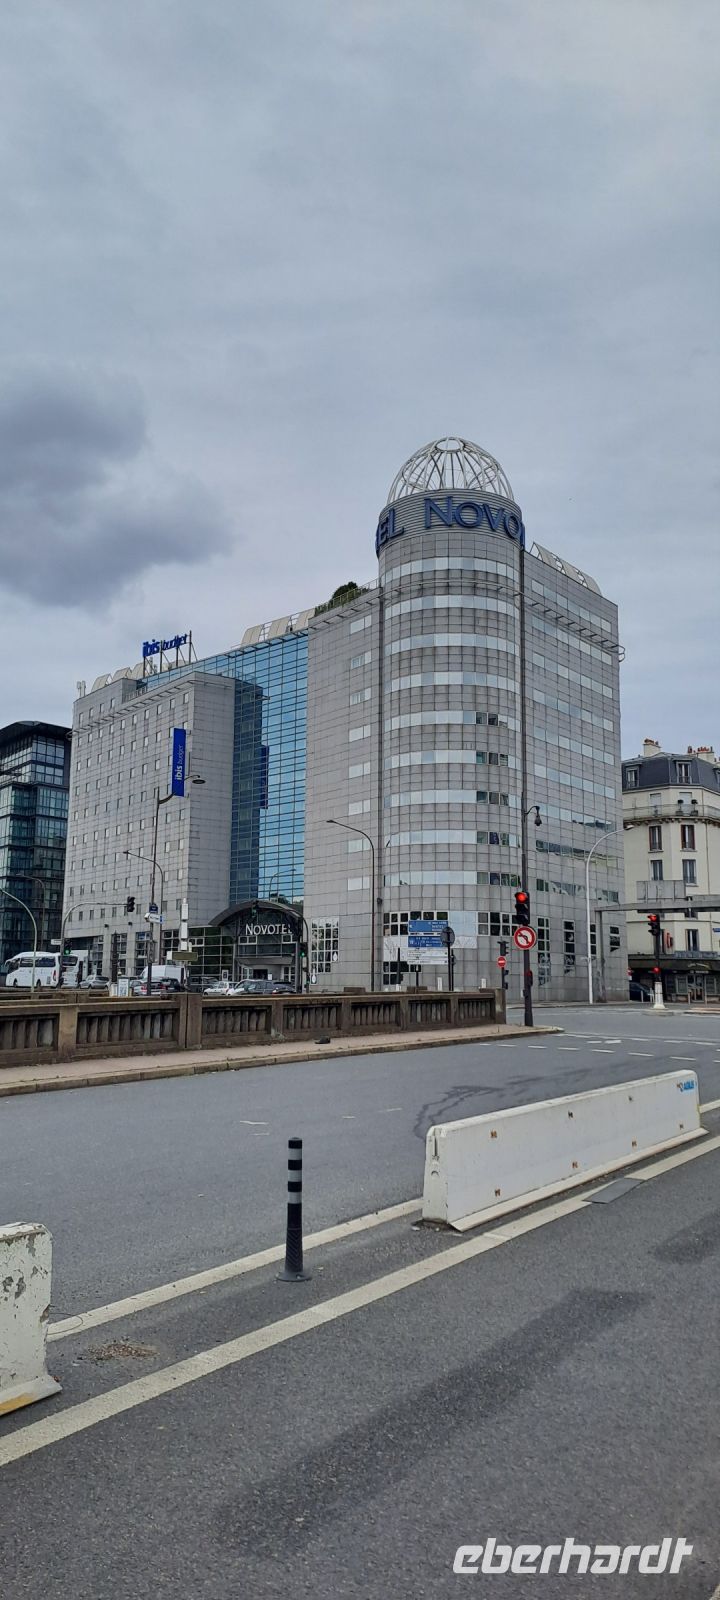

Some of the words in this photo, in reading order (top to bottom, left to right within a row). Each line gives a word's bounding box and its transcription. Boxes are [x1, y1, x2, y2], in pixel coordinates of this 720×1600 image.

[143, 639, 161, 657] ibis
[175, 765, 183, 780] ibis
[245, 923, 293, 936] NOVOTEL
